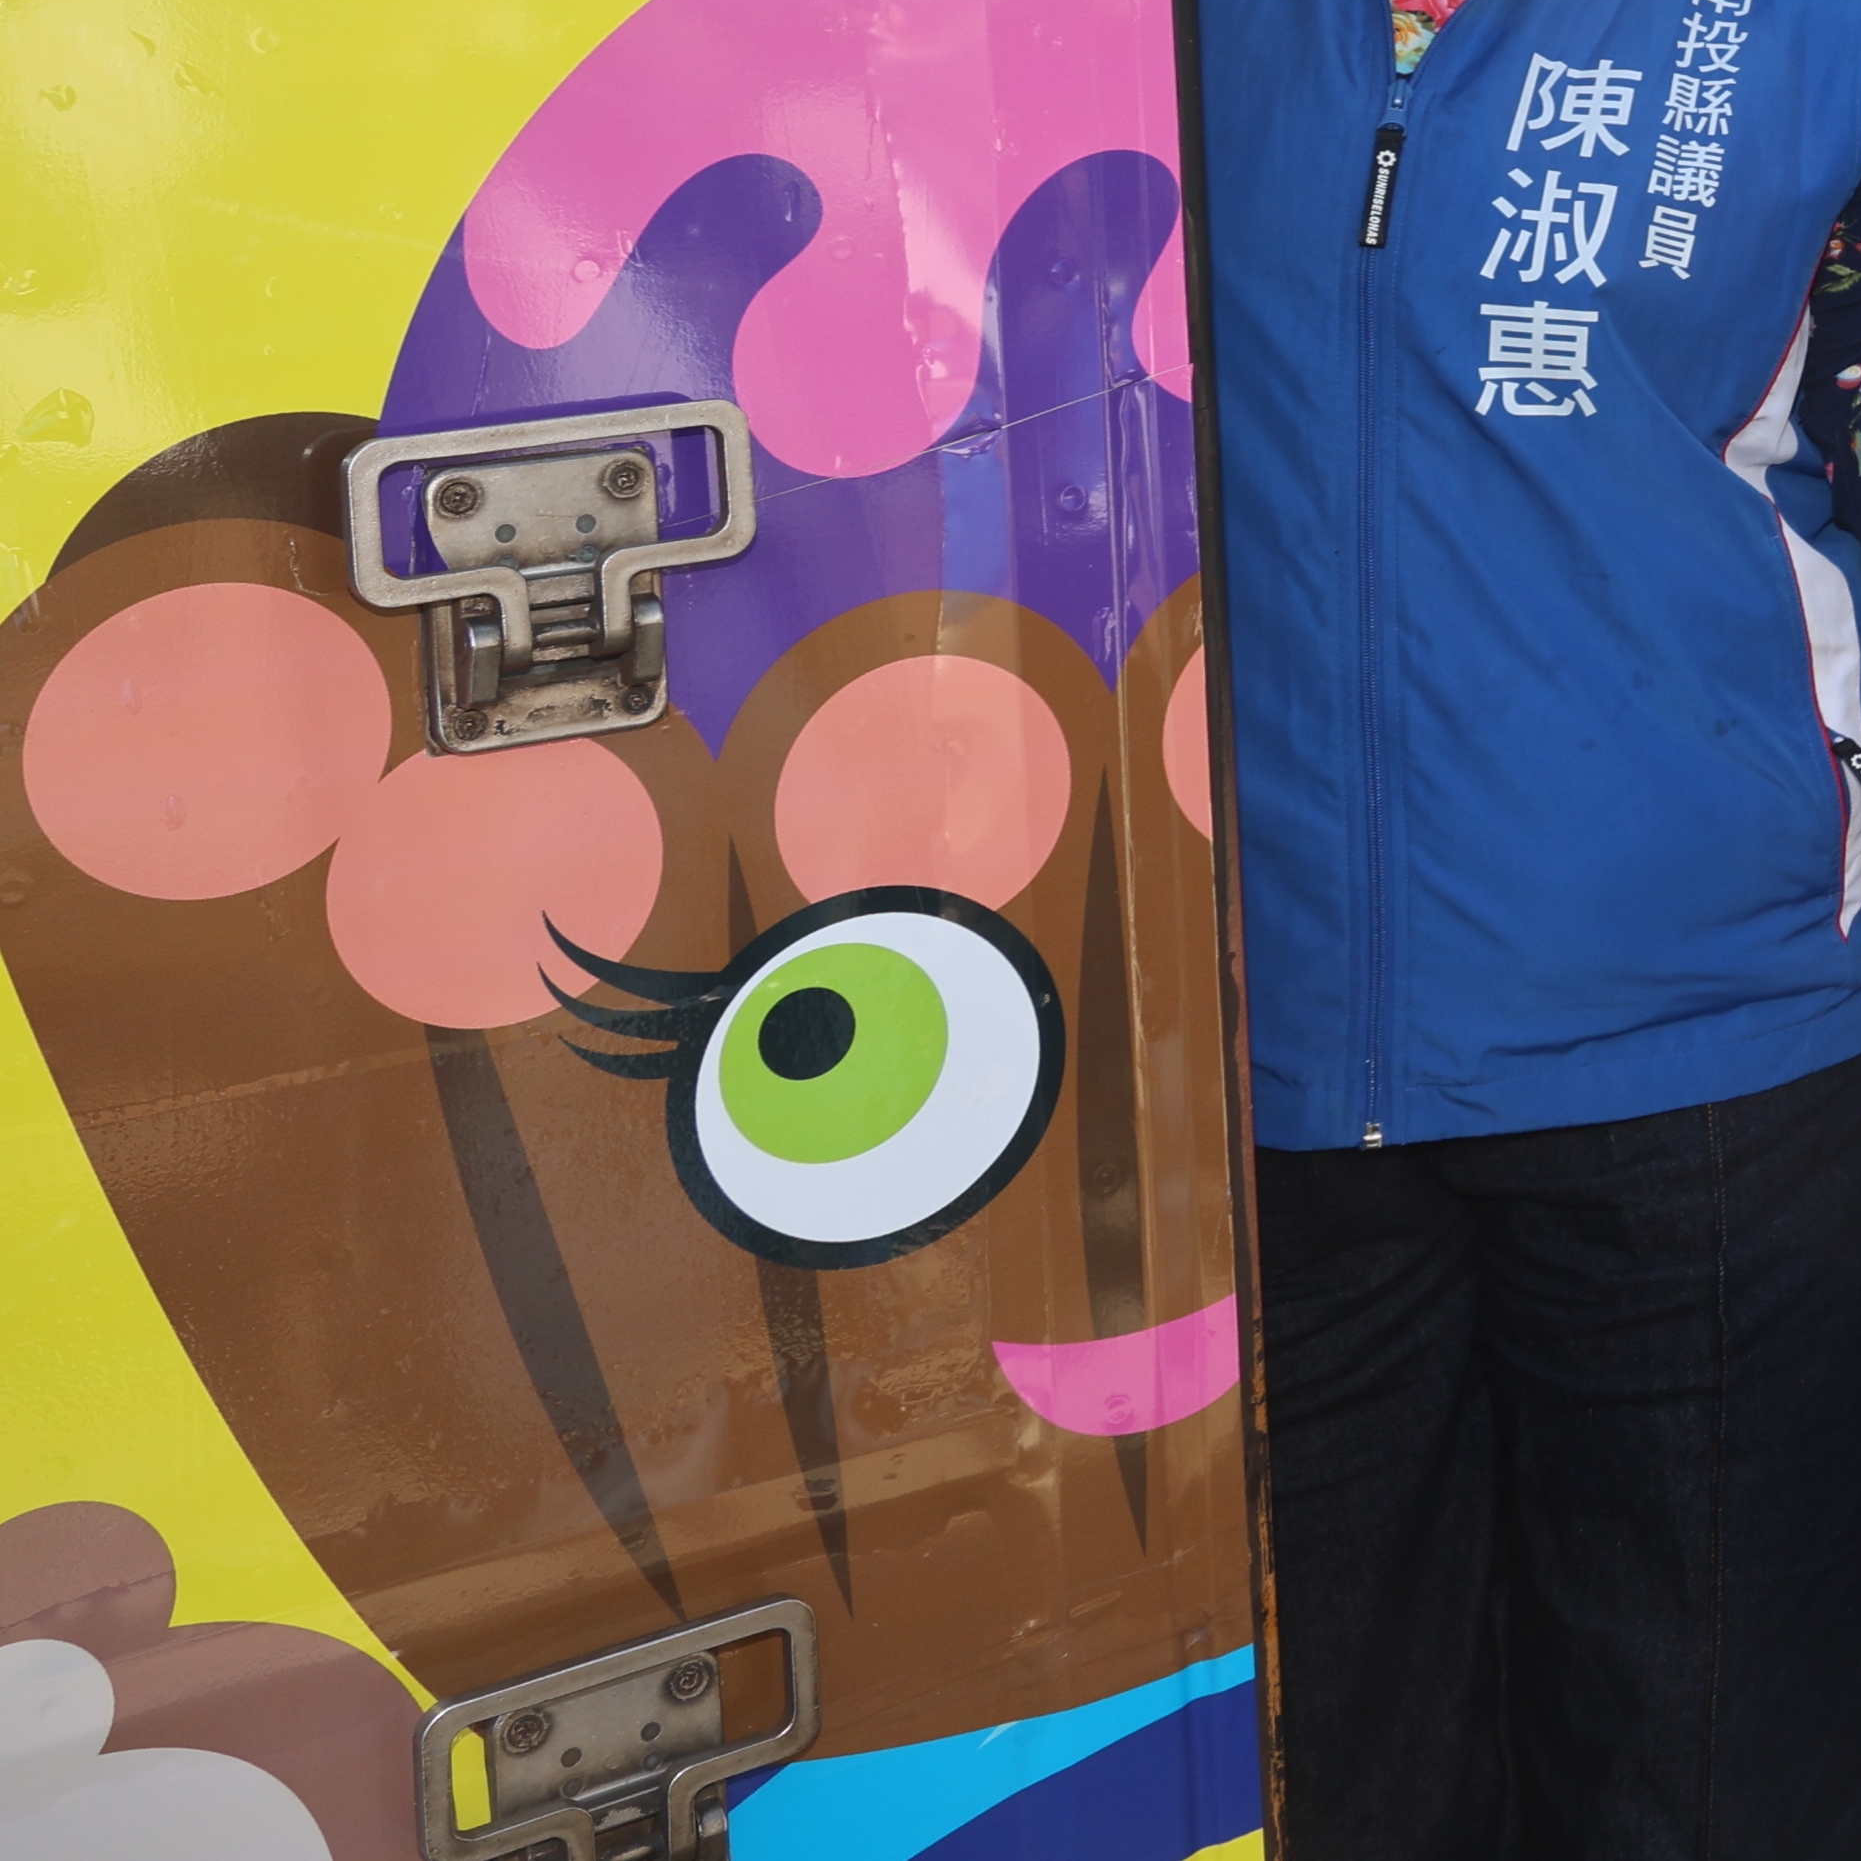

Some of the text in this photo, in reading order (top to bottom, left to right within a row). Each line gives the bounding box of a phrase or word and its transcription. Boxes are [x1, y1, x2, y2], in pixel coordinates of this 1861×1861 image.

[1365, 167, 1391, 246] SUNRISELOHAS
[1474, 52, 1643, 418] 陳淑惠
